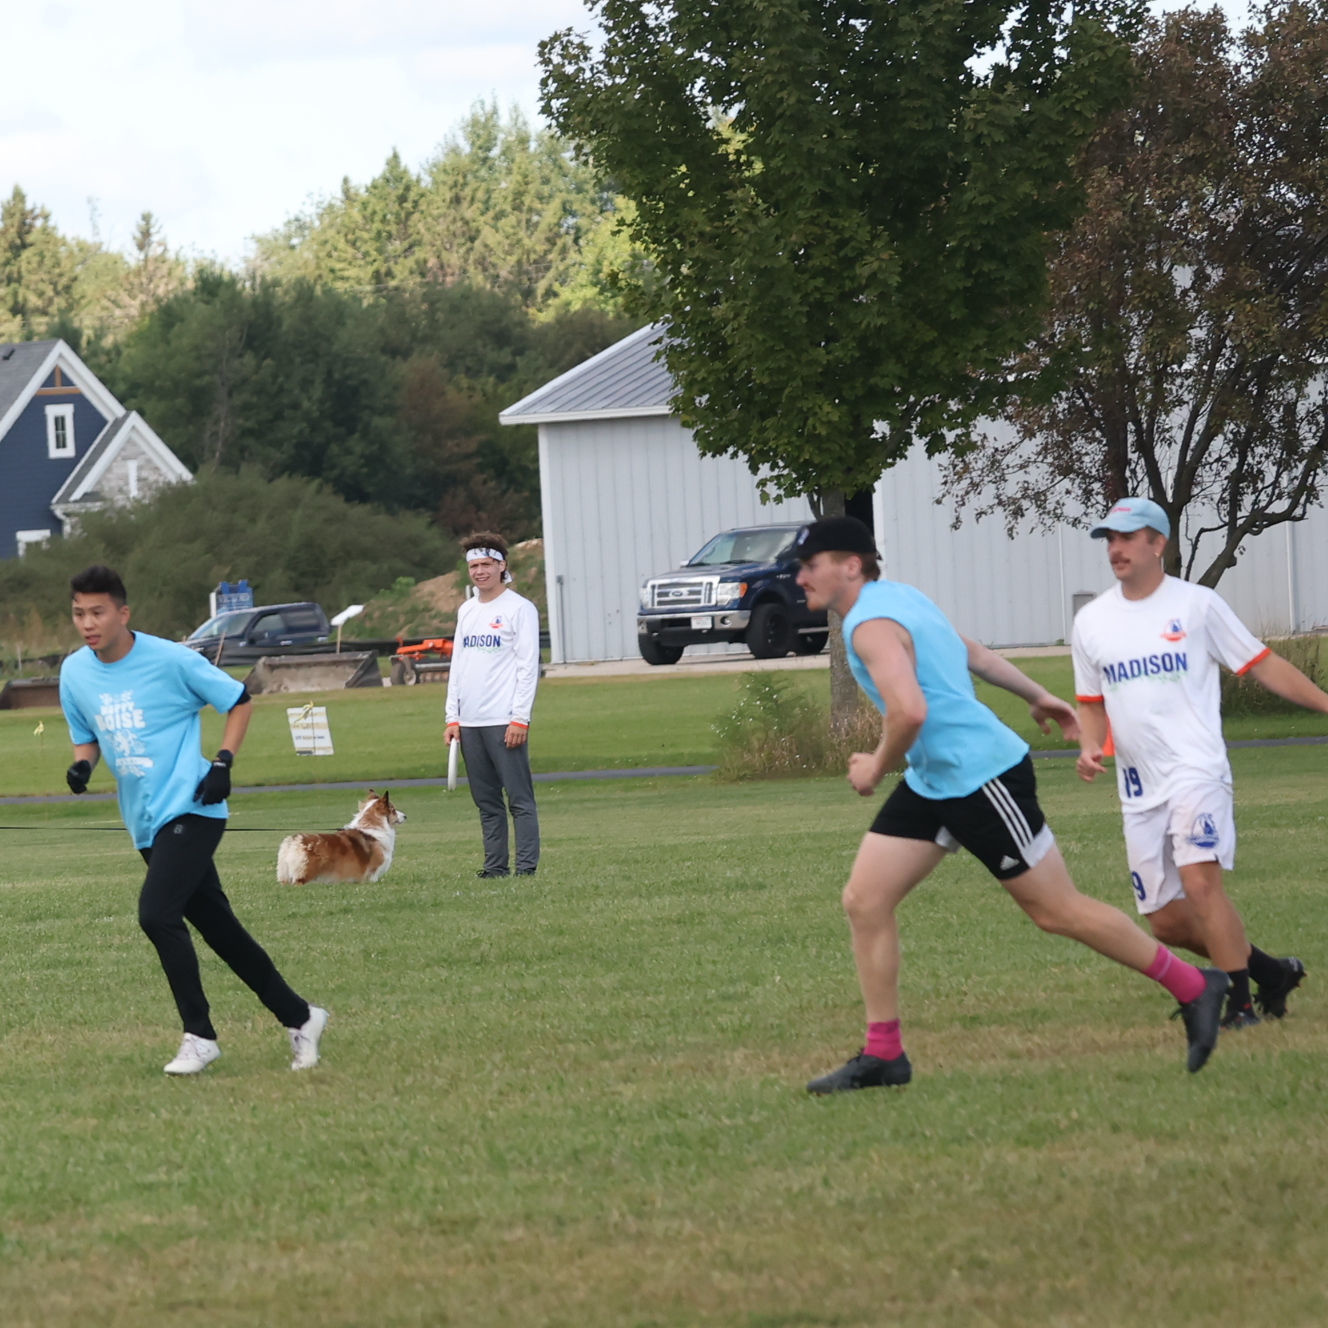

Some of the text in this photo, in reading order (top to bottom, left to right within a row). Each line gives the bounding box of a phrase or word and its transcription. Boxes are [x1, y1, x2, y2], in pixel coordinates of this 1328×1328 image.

[462, 634, 501, 648] ADISON
[1103, 652, 1188, 685] MADISON
[1123, 766, 1143, 798] 19
